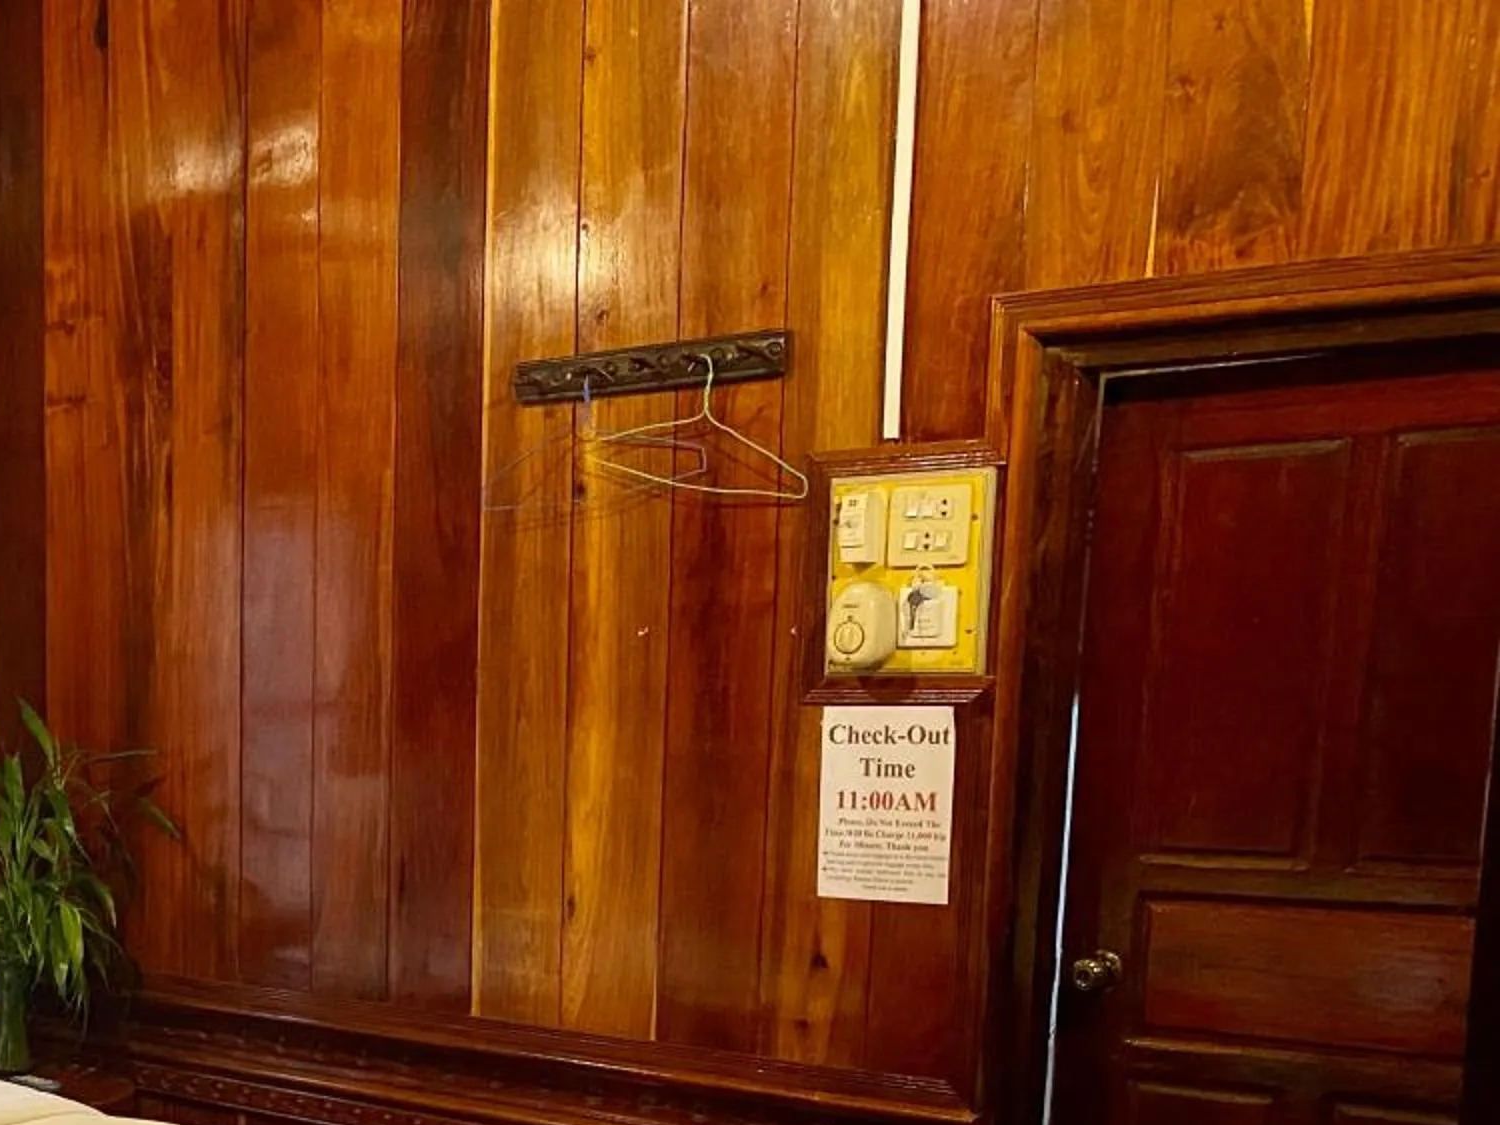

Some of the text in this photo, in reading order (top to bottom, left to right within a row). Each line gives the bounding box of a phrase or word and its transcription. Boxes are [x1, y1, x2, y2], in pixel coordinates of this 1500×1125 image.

[828, 723, 950, 745] Check-Out
[859, 757, 916, 779] Time
[837, 789, 938, 812] 11:00AM
